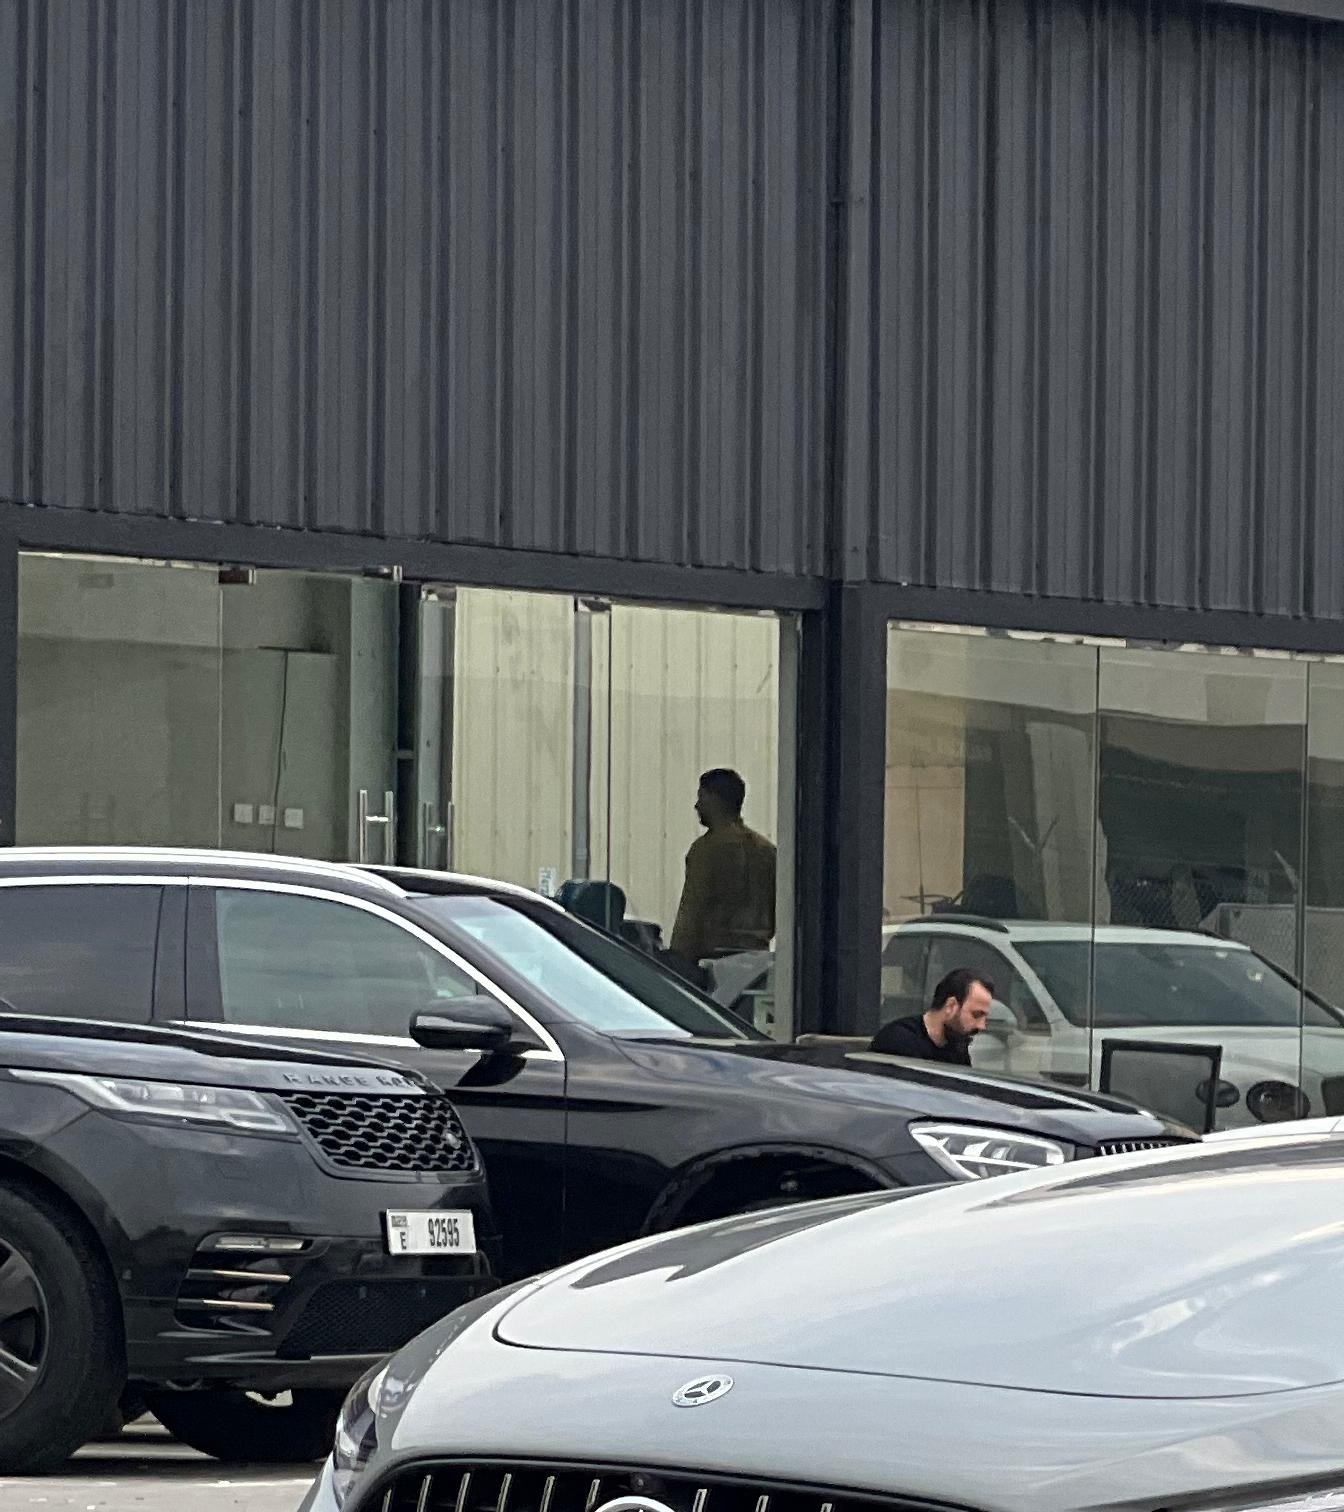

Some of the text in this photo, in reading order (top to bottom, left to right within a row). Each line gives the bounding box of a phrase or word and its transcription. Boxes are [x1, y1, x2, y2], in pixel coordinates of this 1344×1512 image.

[282, 1072, 368, 1087] RANGE
[399, 1231, 408, 1251] E
[428, 1217, 460, 1248] 92595
